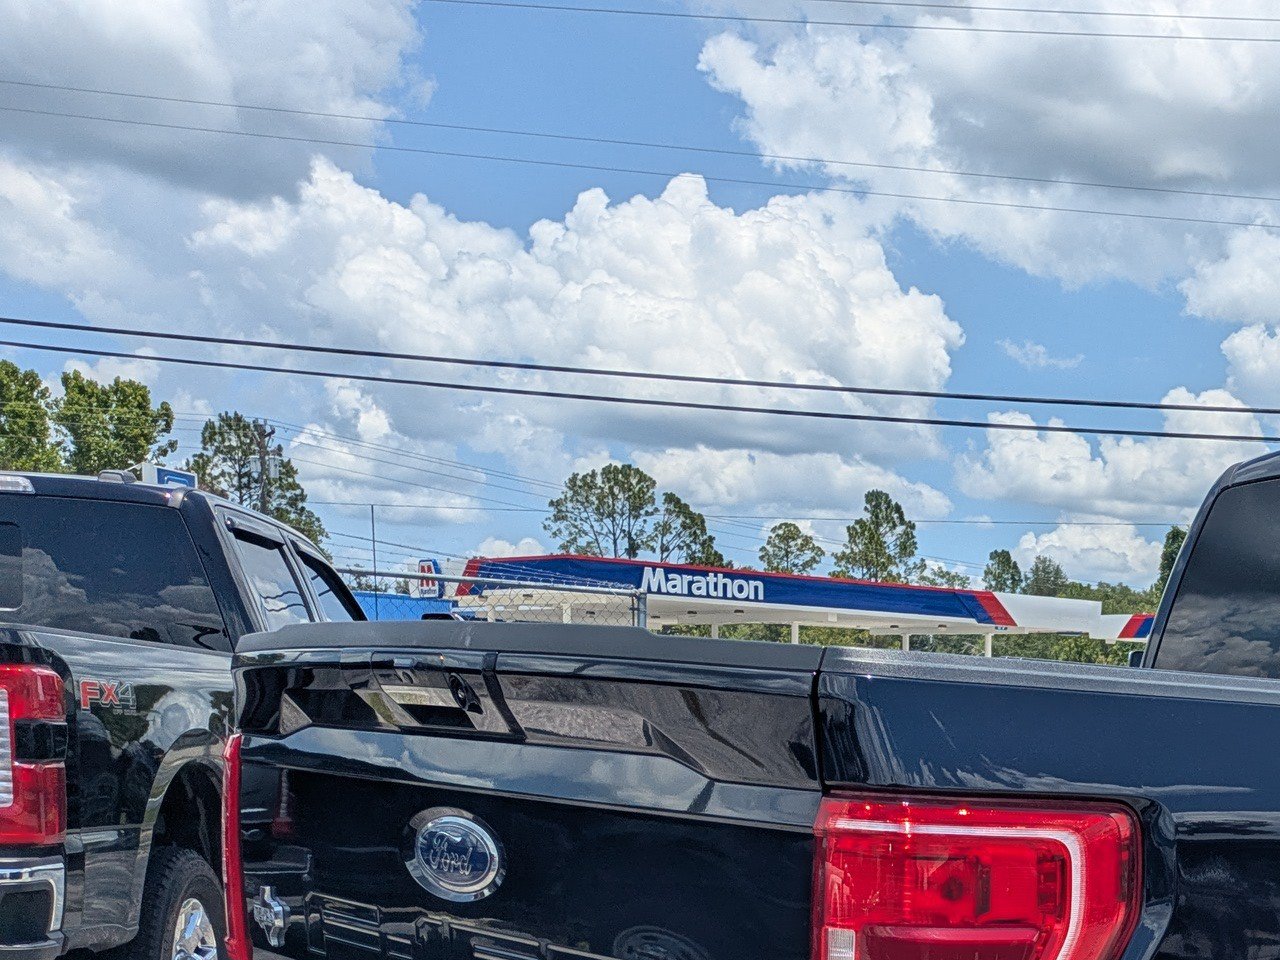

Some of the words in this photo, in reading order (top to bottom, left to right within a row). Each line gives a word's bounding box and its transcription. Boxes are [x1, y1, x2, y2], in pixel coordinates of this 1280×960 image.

[642, 567, 764, 600] Marathon
[80, 679, 137, 711] FX4
[430, 831, 472, 876] Ford
